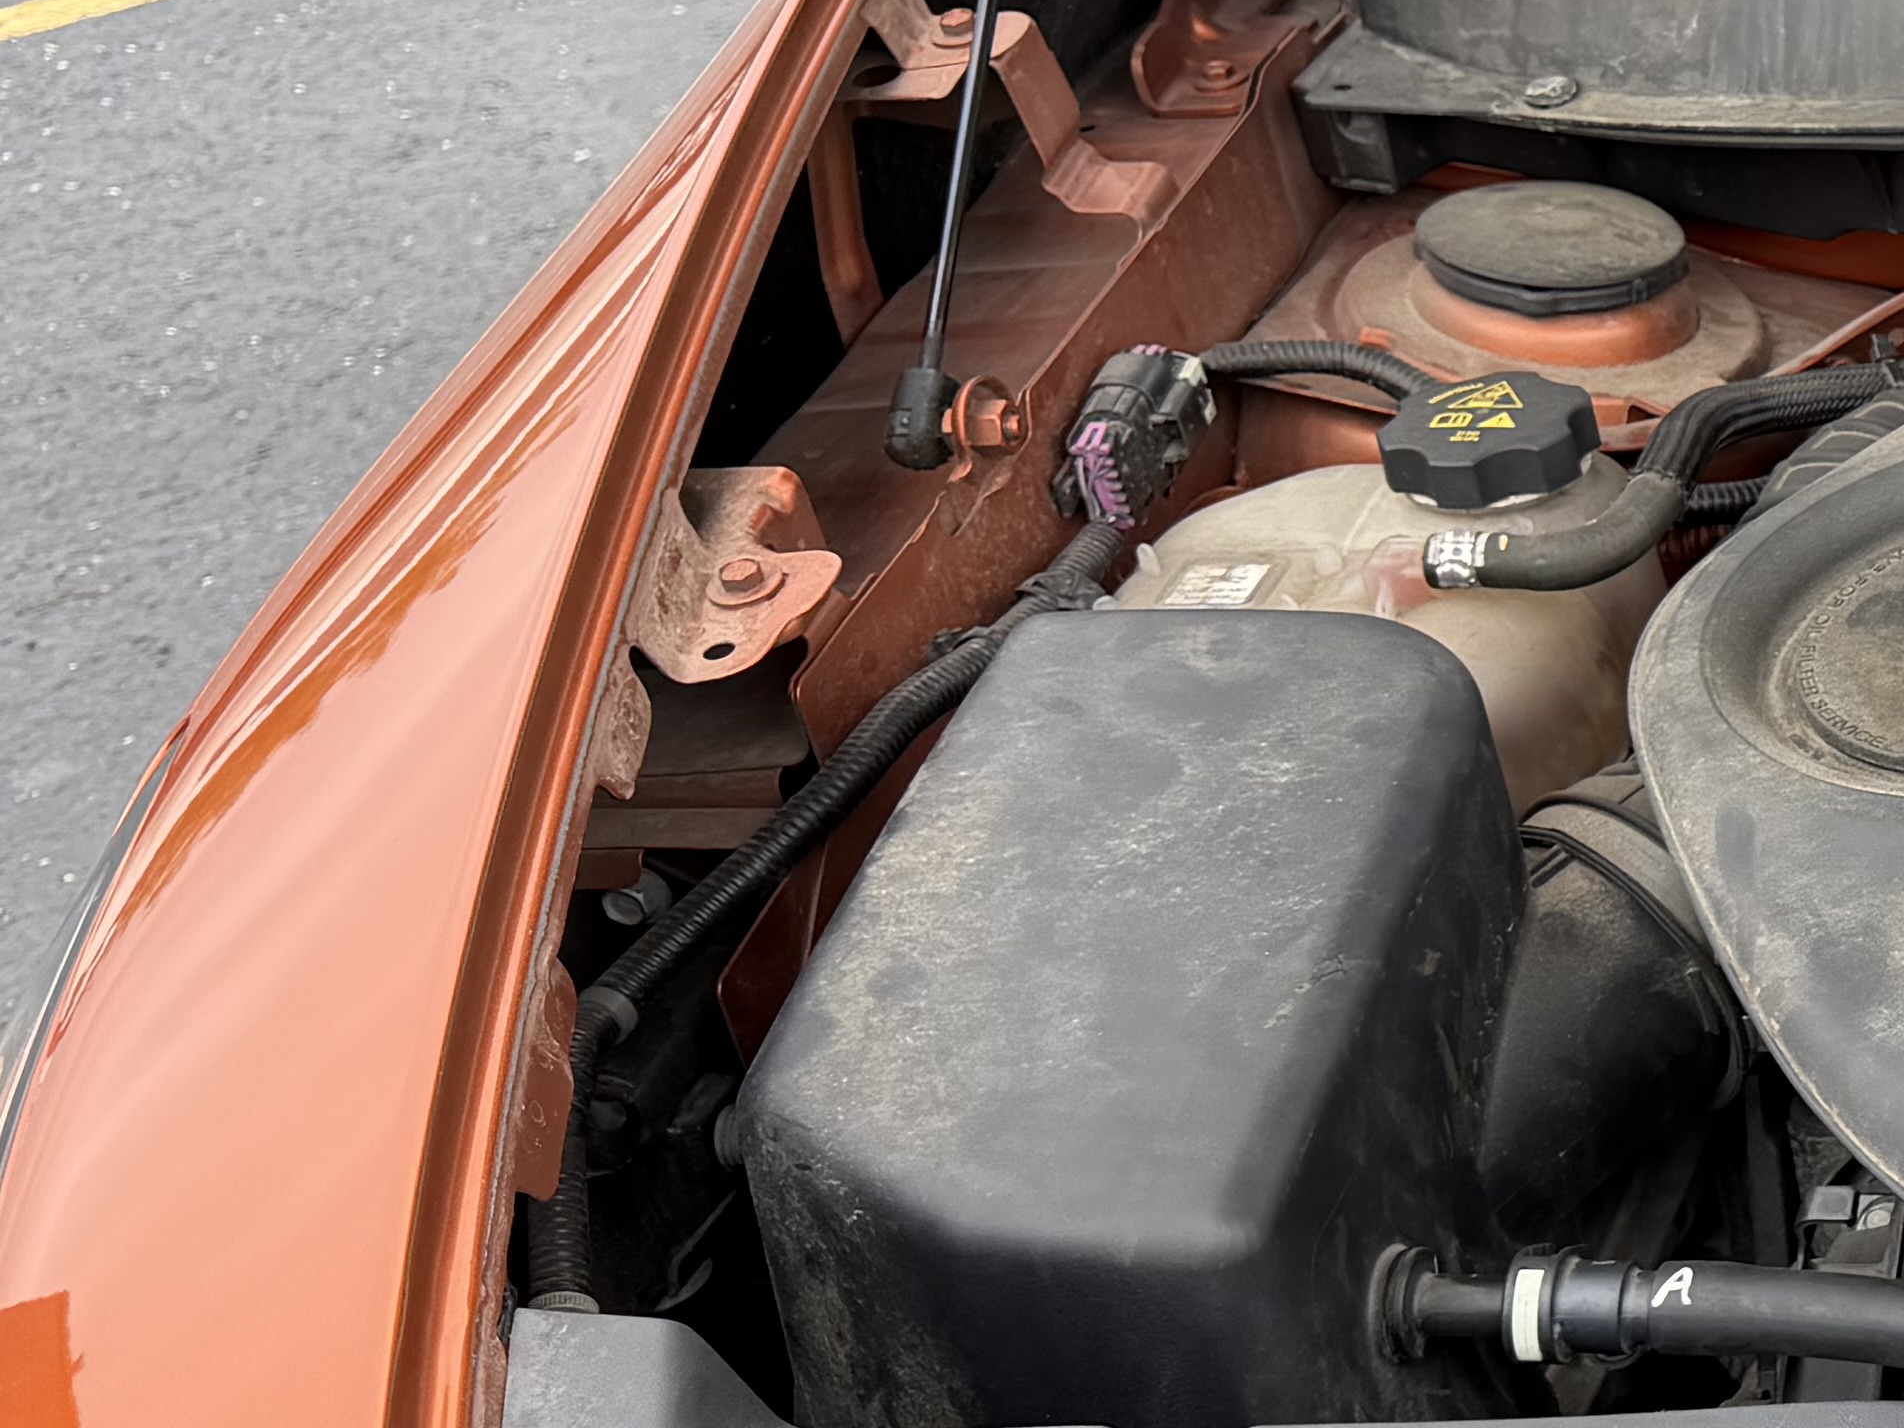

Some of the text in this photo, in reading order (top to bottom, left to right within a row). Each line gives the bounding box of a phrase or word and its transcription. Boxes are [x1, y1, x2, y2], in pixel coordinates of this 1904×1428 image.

[1826, 576, 1868, 609] FOR
[1803, 613, 1831, 638] OIL
[1799, 643, 1820, 697] FILTER
[1810, 698, 1889, 749] SERVICE
[1651, 1266, 1693, 1308] A
